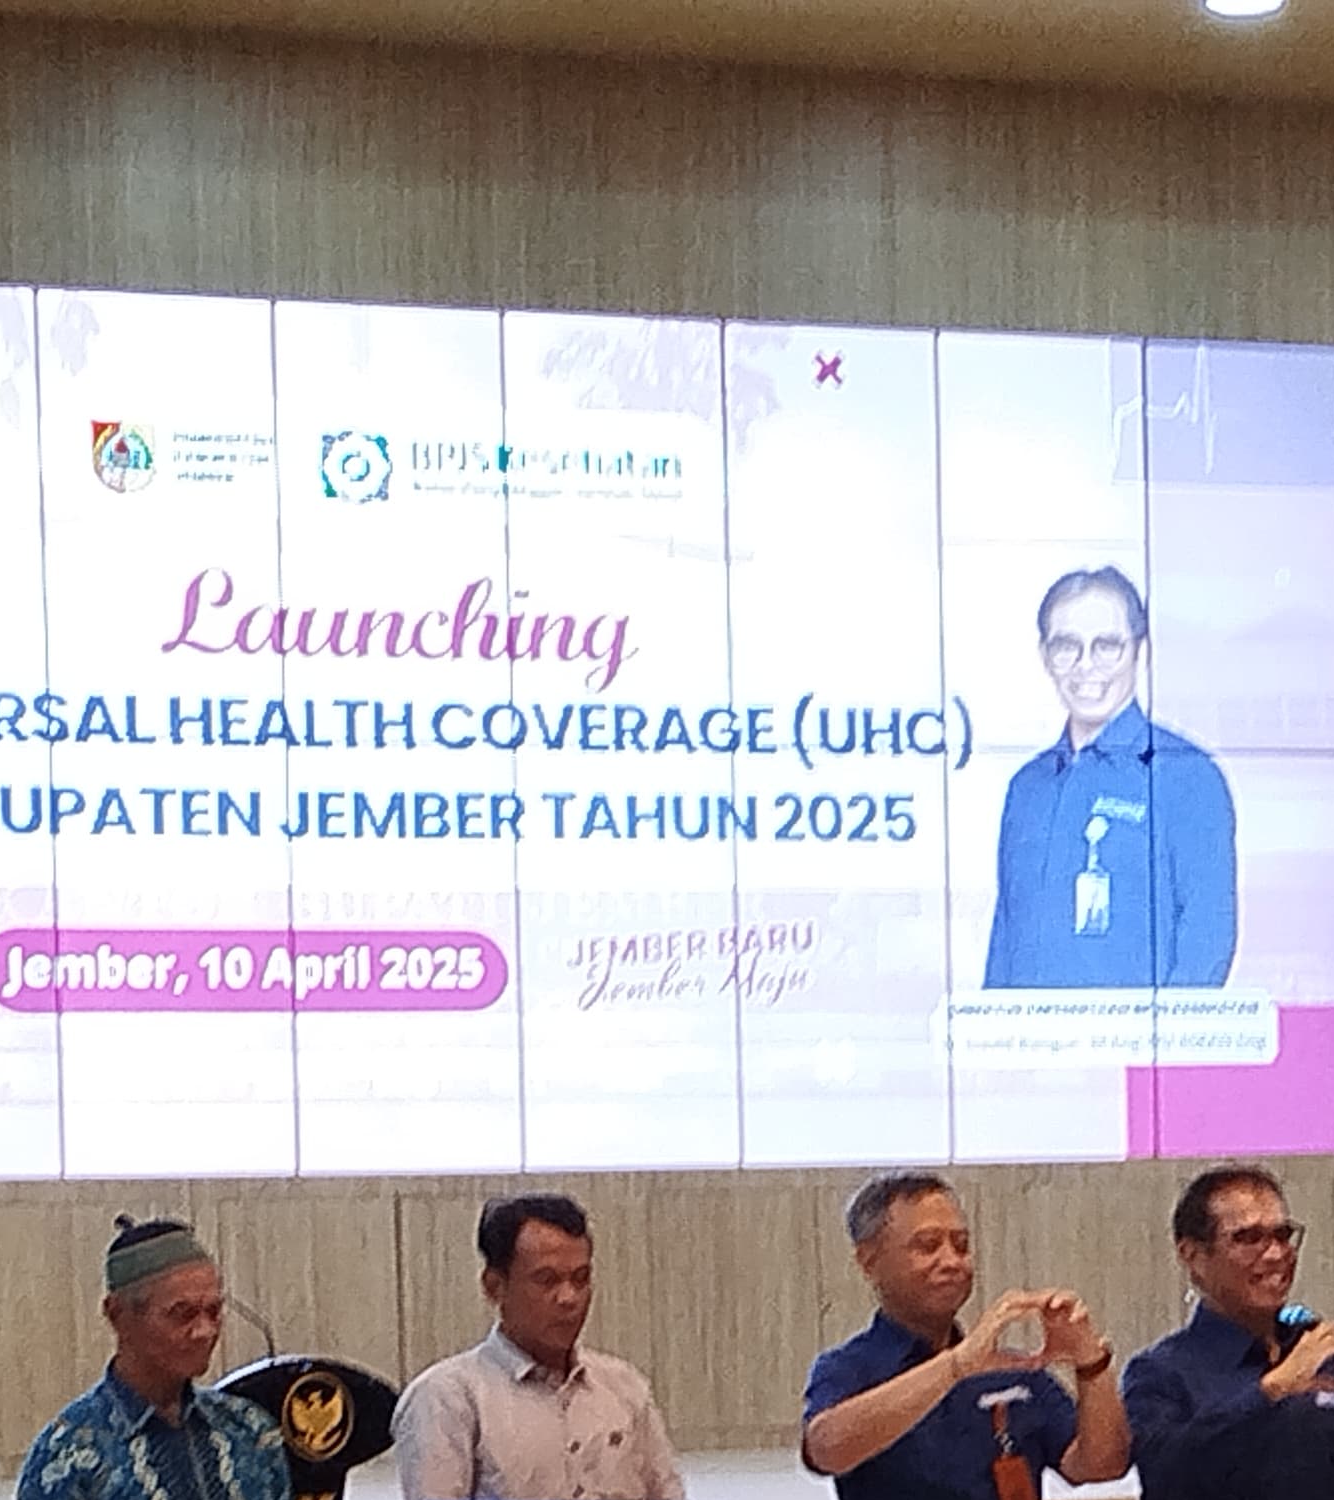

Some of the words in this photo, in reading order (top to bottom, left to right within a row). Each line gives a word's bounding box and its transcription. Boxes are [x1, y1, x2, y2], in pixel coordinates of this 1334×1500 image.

[161, 567, 640, 694] Launching
[169, 696, 415, 749] HEALTH
[432, 702, 778, 754] COVERAGE
[792, 692, 973, 770] (UHC)
[280, 790, 527, 842] JEMBER
[541, 793, 758, 840] TAHUN
[773, 792, 916, 842] 2025
[1, 944, 189, 999] Jember,
[199, 945, 255, 991] 10
[261, 944, 370, 1000] April
[379, 946, 487, 992] 2025
[566, 929, 708, 969] JEMBER
[717, 920, 816, 955] BARU
